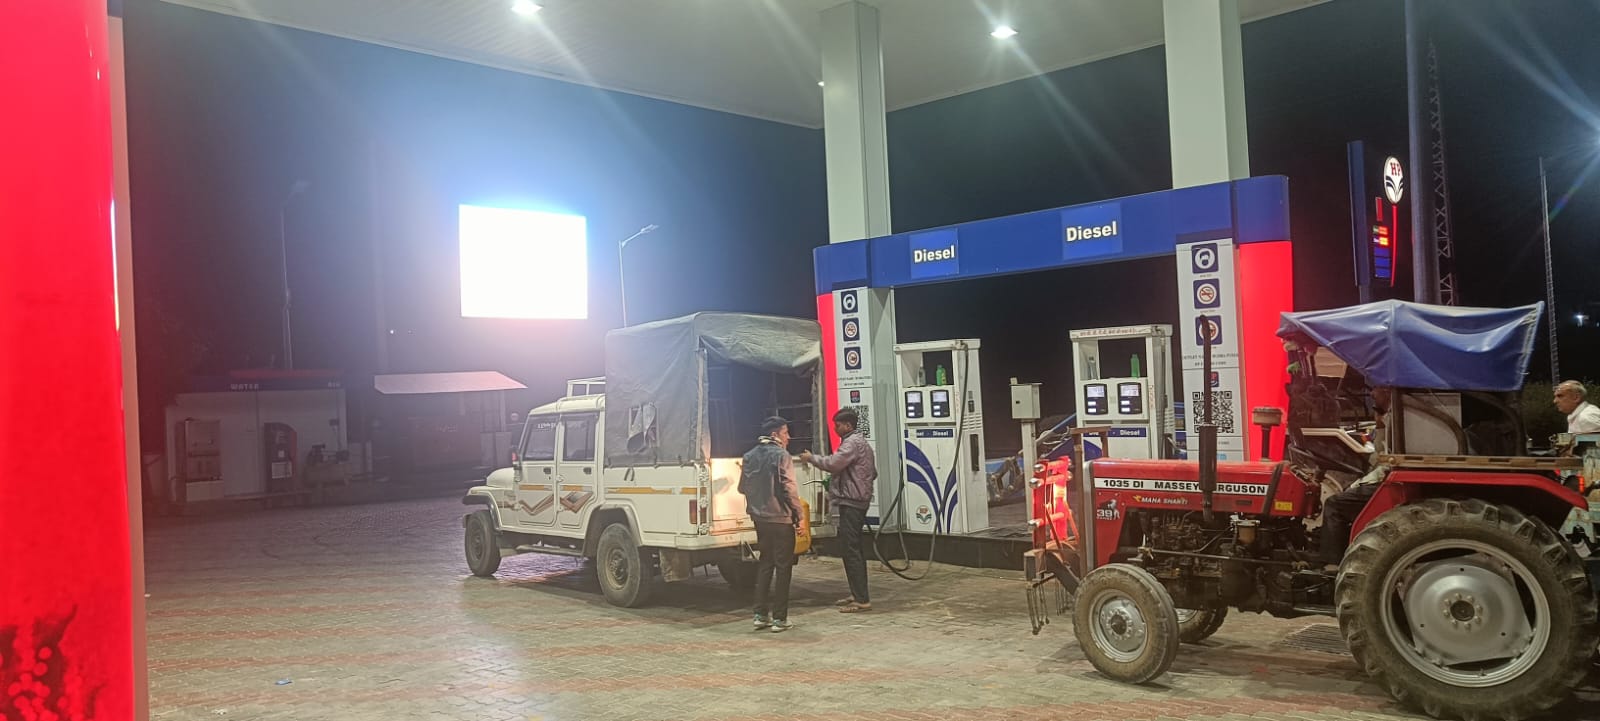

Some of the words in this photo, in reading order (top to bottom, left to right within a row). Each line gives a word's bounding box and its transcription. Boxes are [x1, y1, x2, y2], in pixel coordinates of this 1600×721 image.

[1066, 221, 1118, 242] Diesel
[914, 245, 955, 263] Diesel
[1103, 479, 1129, 488] 1035
[1133, 480, 1144, 488] DI
[1154, 481, 1200, 491] MASSEY
[1218, 484, 1266, 494] RGUSON
[1141, 496, 1160, 504] MAHA
[1096, 509, 1113, 517] 39
